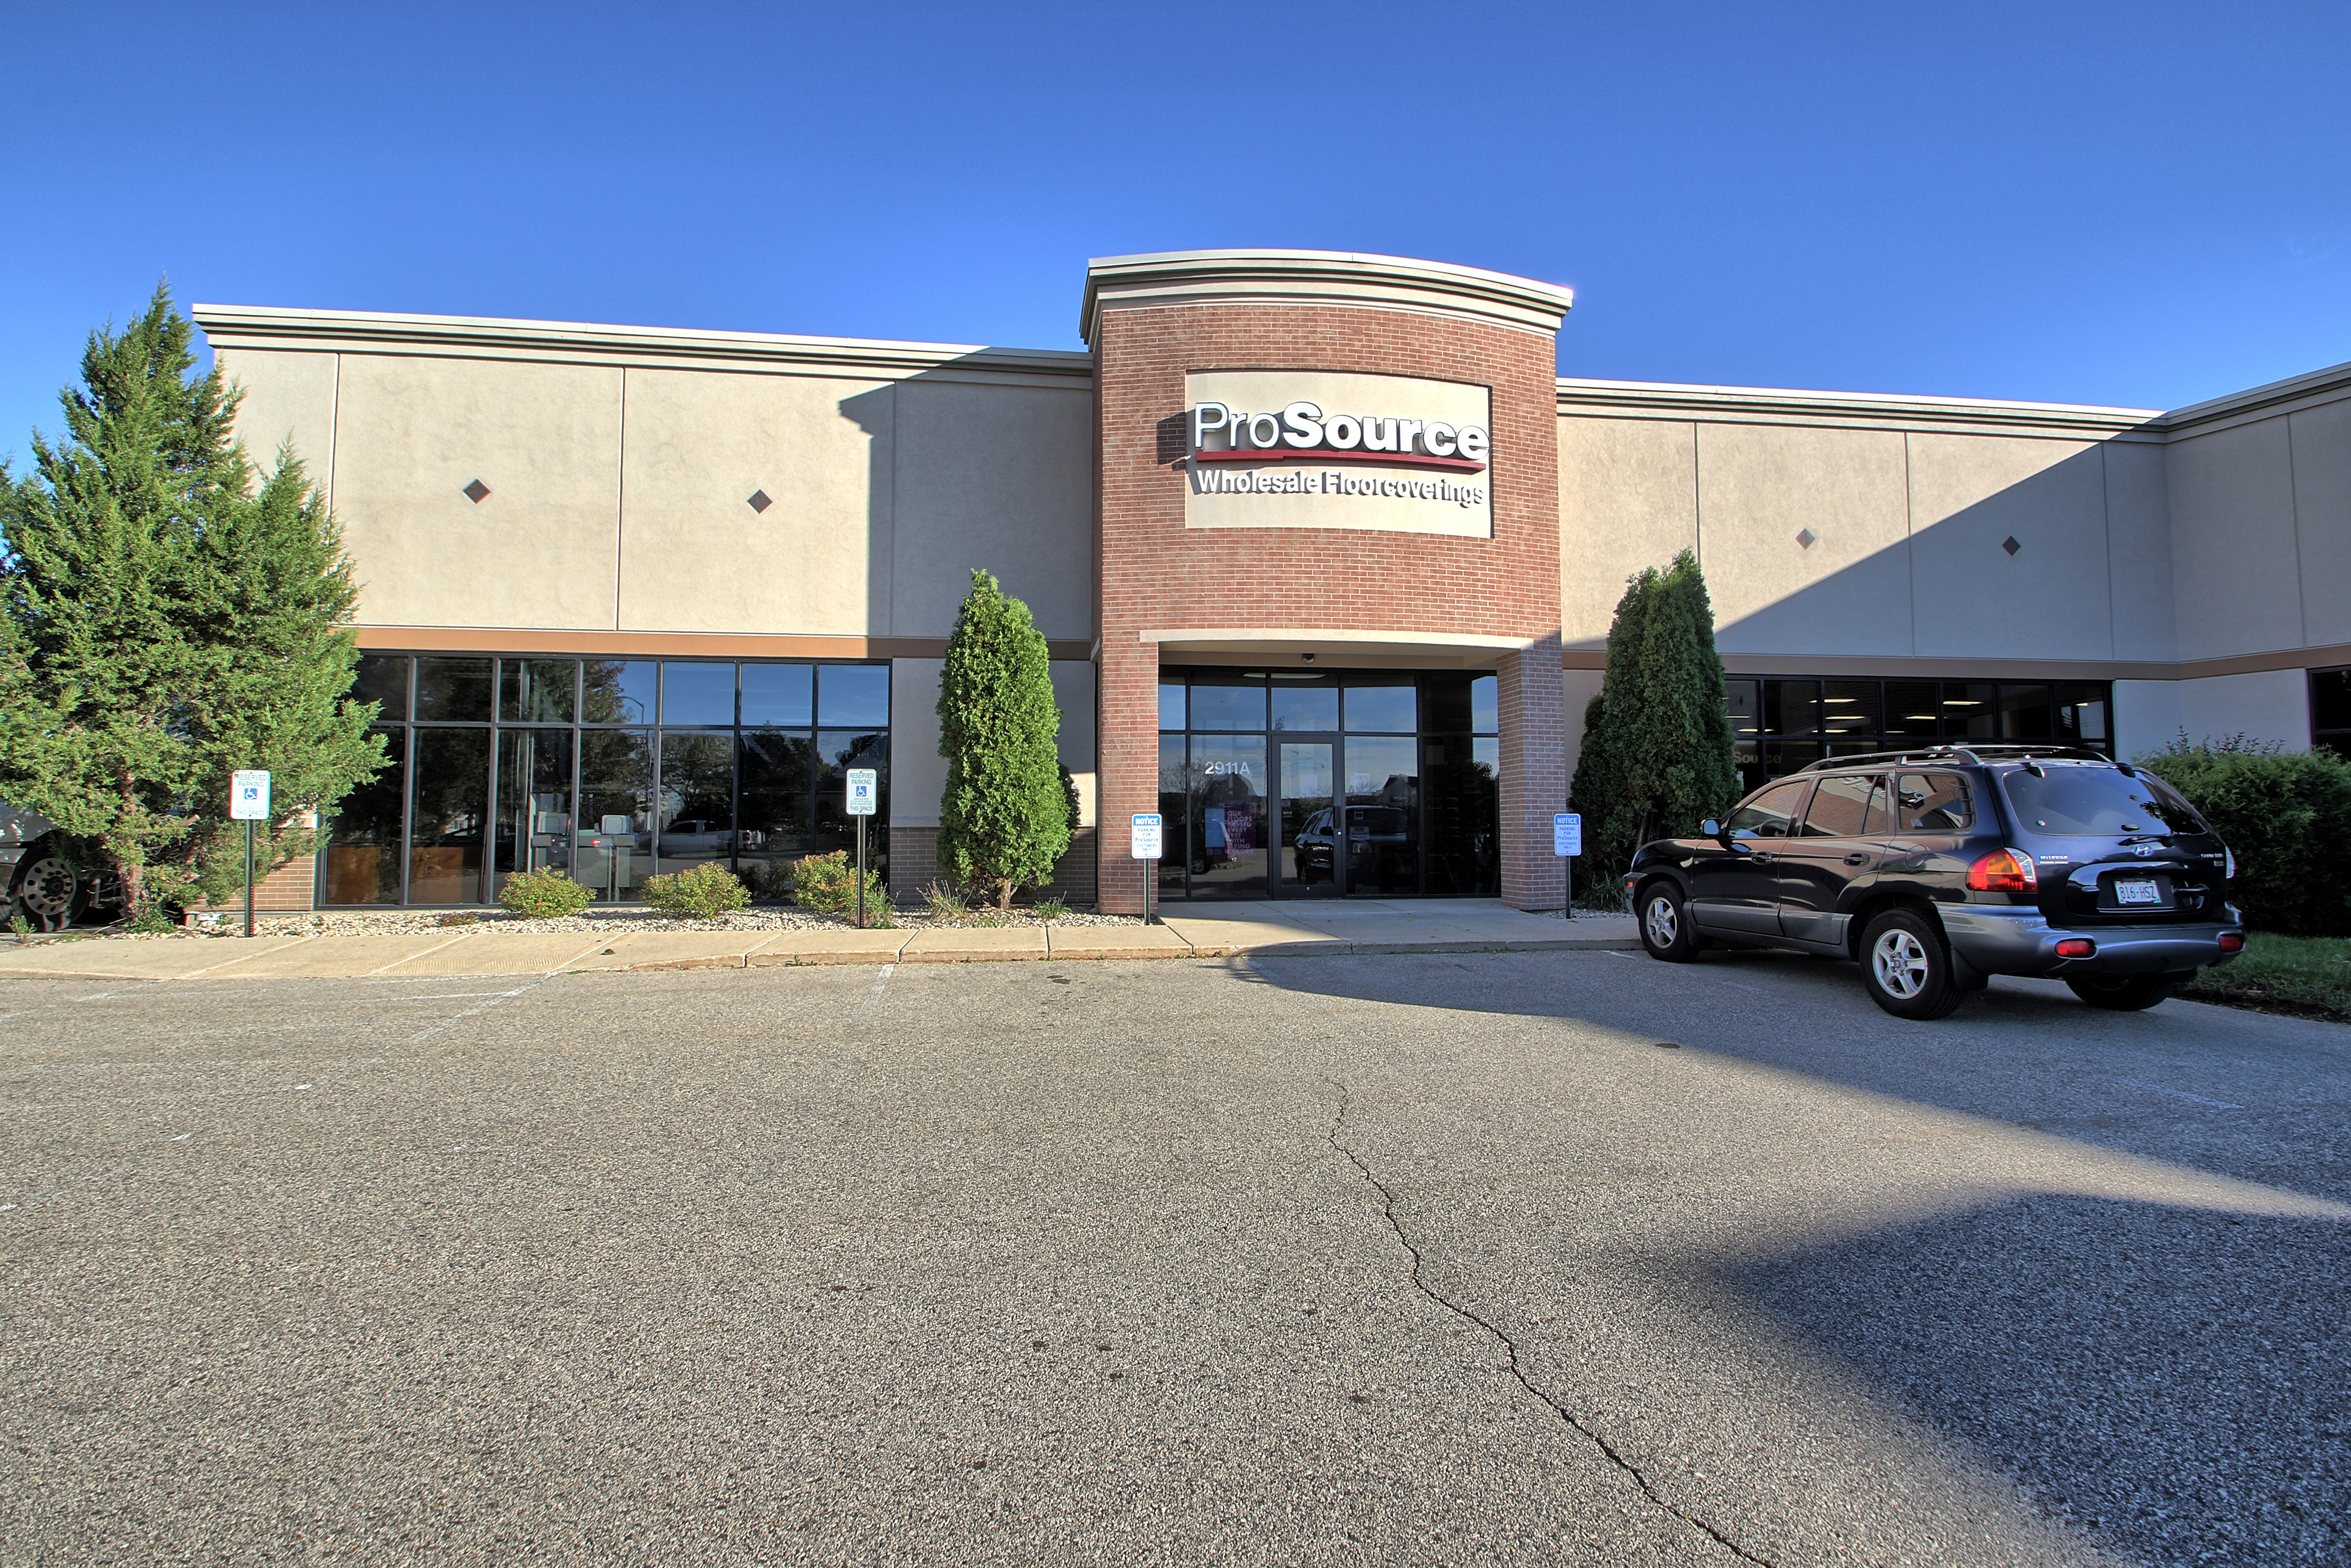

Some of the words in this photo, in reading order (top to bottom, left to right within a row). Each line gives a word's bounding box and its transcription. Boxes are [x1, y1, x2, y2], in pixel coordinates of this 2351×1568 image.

[1195, 401, 1490, 460] ProSource
[1196, 469, 1318, 493] Wholesale
[1325, 470, 1487, 507] Floorcoverings
[1205, 762, 1250, 774] 2911A
[2119, 886, 2156, 898] 816-HSZ
